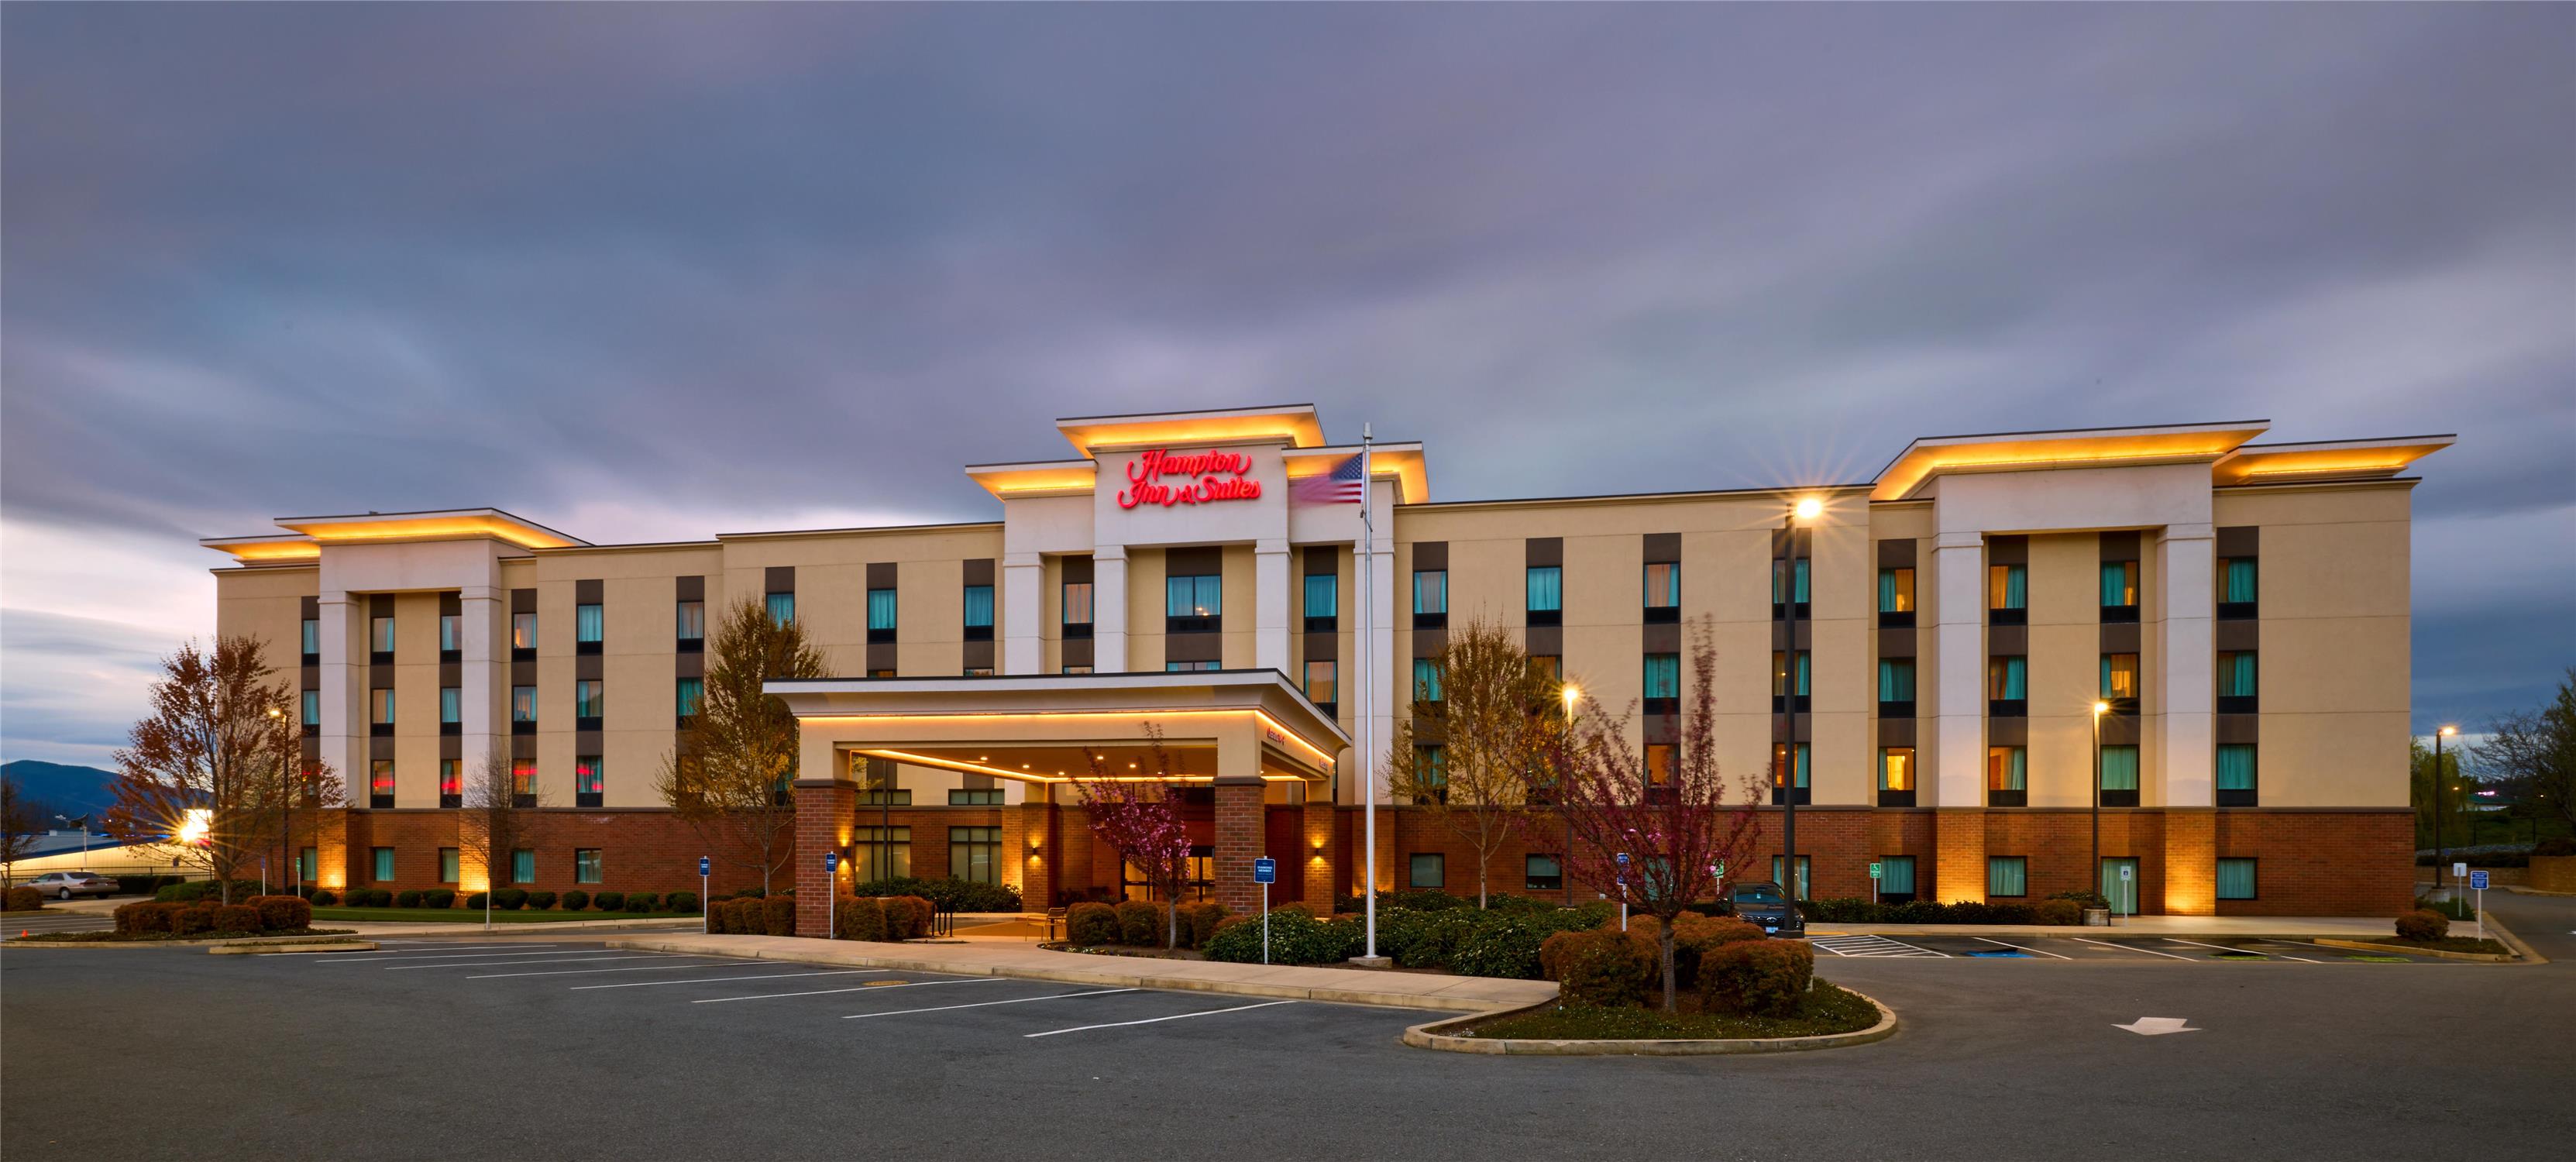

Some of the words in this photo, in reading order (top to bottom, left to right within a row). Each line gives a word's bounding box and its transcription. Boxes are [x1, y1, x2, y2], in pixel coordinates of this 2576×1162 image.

[1126, 448, 1252, 483] Hampton
[1117, 480, 1179, 509] Inn
[1178, 484, 1196, 504] &
[1193, 475, 1262, 502] Suites
